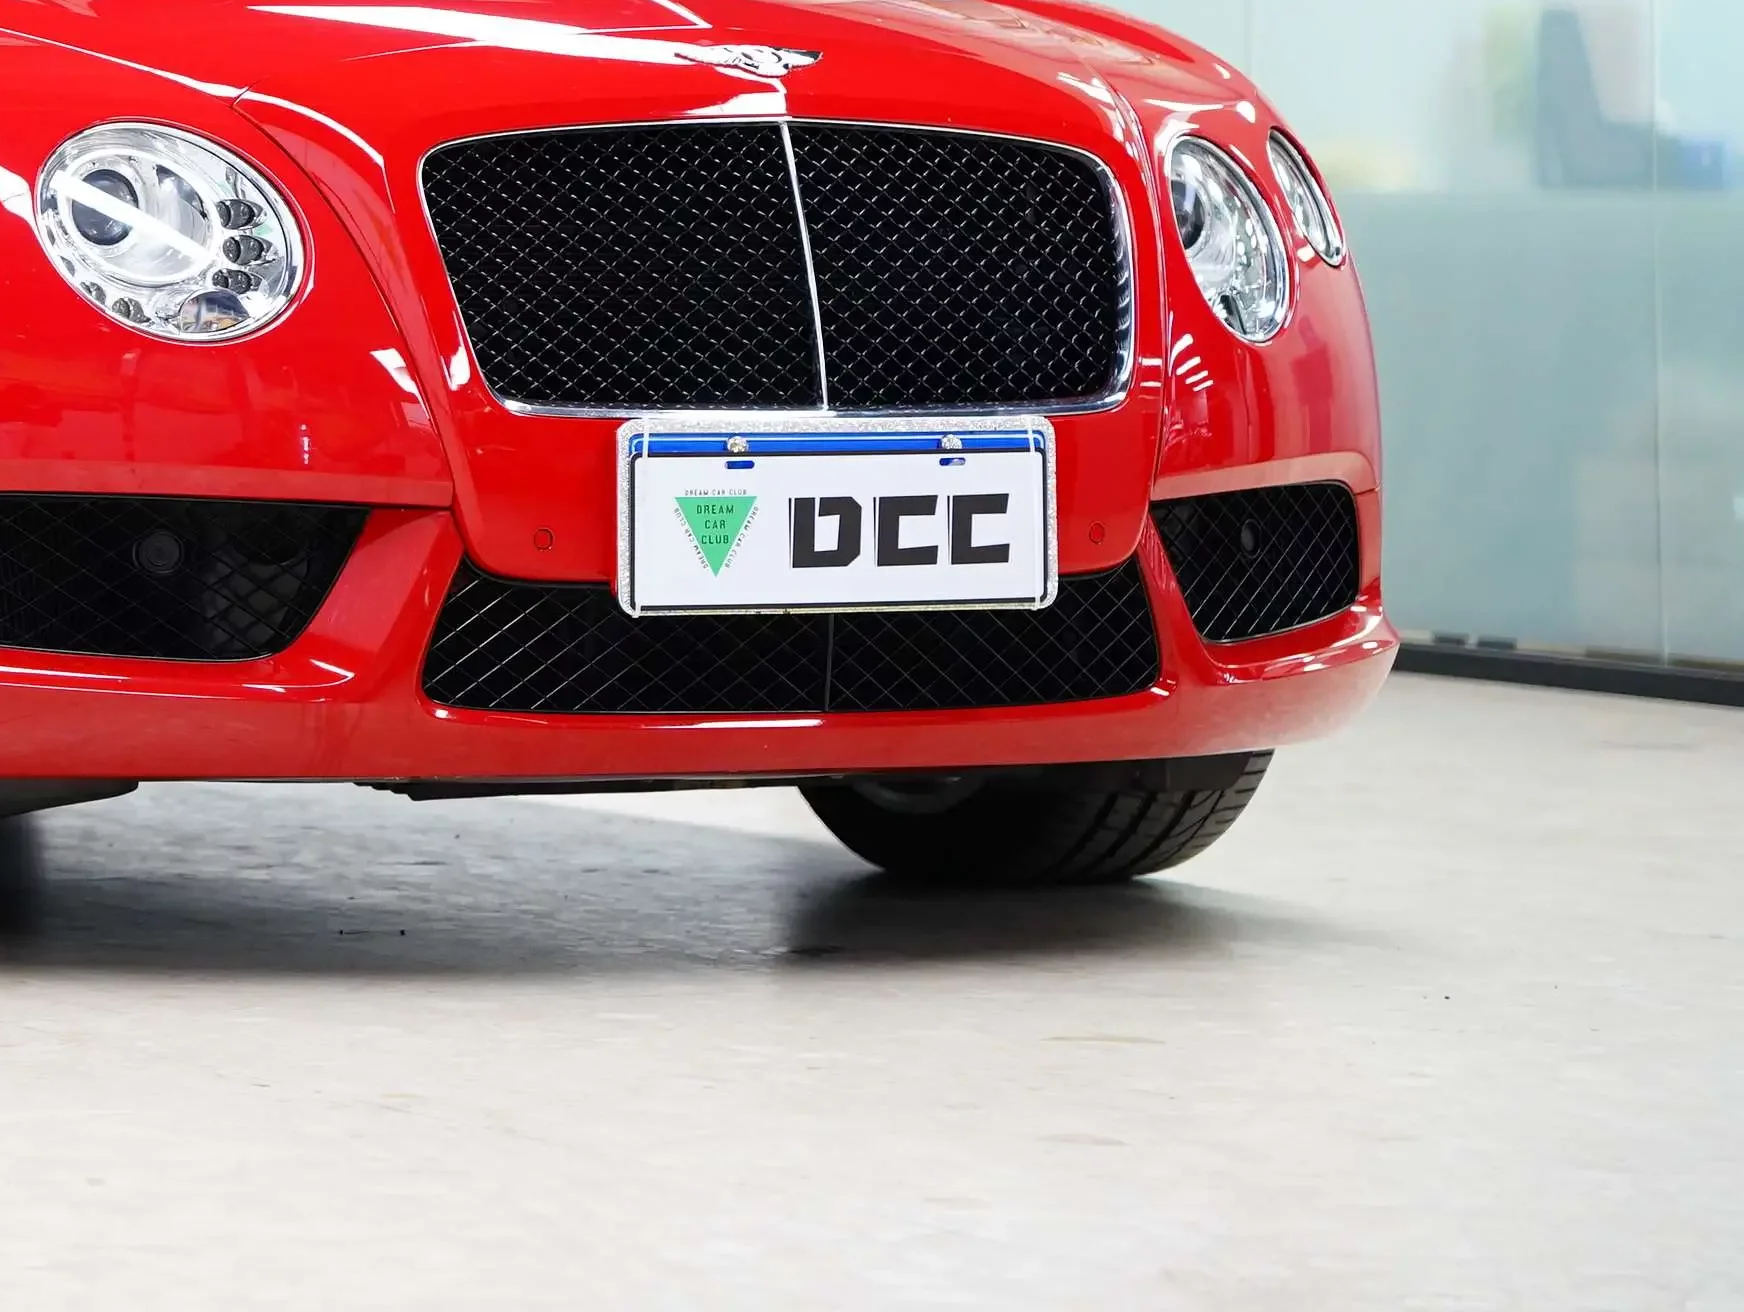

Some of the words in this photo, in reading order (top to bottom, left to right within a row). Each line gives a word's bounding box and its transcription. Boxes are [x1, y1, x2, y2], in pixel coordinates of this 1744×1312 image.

[696, 504, 734, 514] DREAM
[704, 519, 726, 530] CAR
[788, 493, 1010, 569] DCC
[701, 534, 729, 545] CLUB
